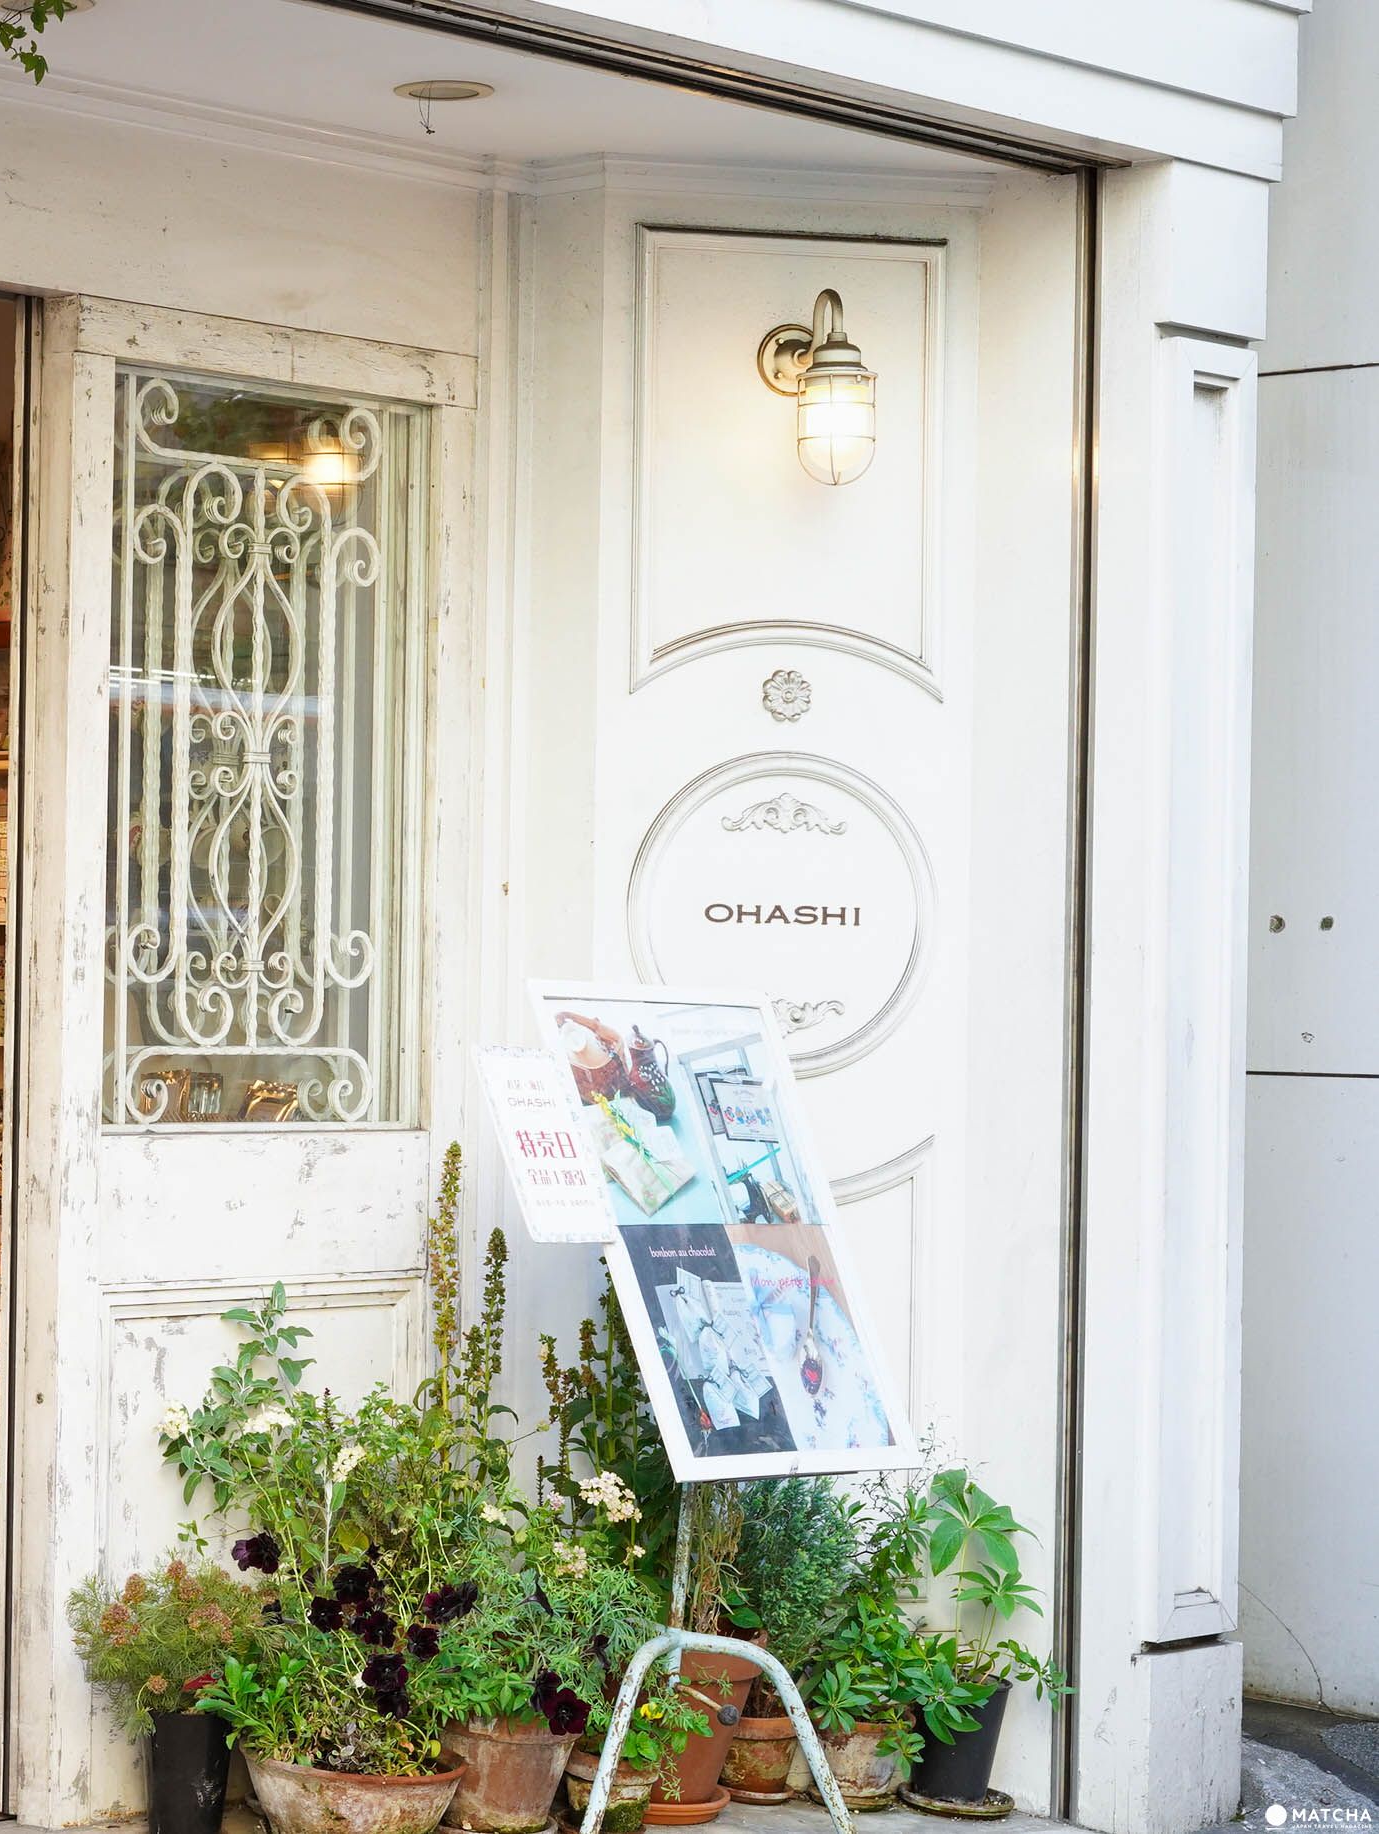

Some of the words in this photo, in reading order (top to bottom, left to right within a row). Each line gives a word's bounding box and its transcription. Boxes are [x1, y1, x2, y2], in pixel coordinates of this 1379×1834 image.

[704, 903, 861, 926] OHASHI
[507, 1097, 557, 1109] OHASHI
[515, 1130, 577, 1158] 特売日
[649, 1246, 678, 1258] bonbon
[678, 1249, 689, 1257] au
[688, 1245, 717, 1257] chocolat
